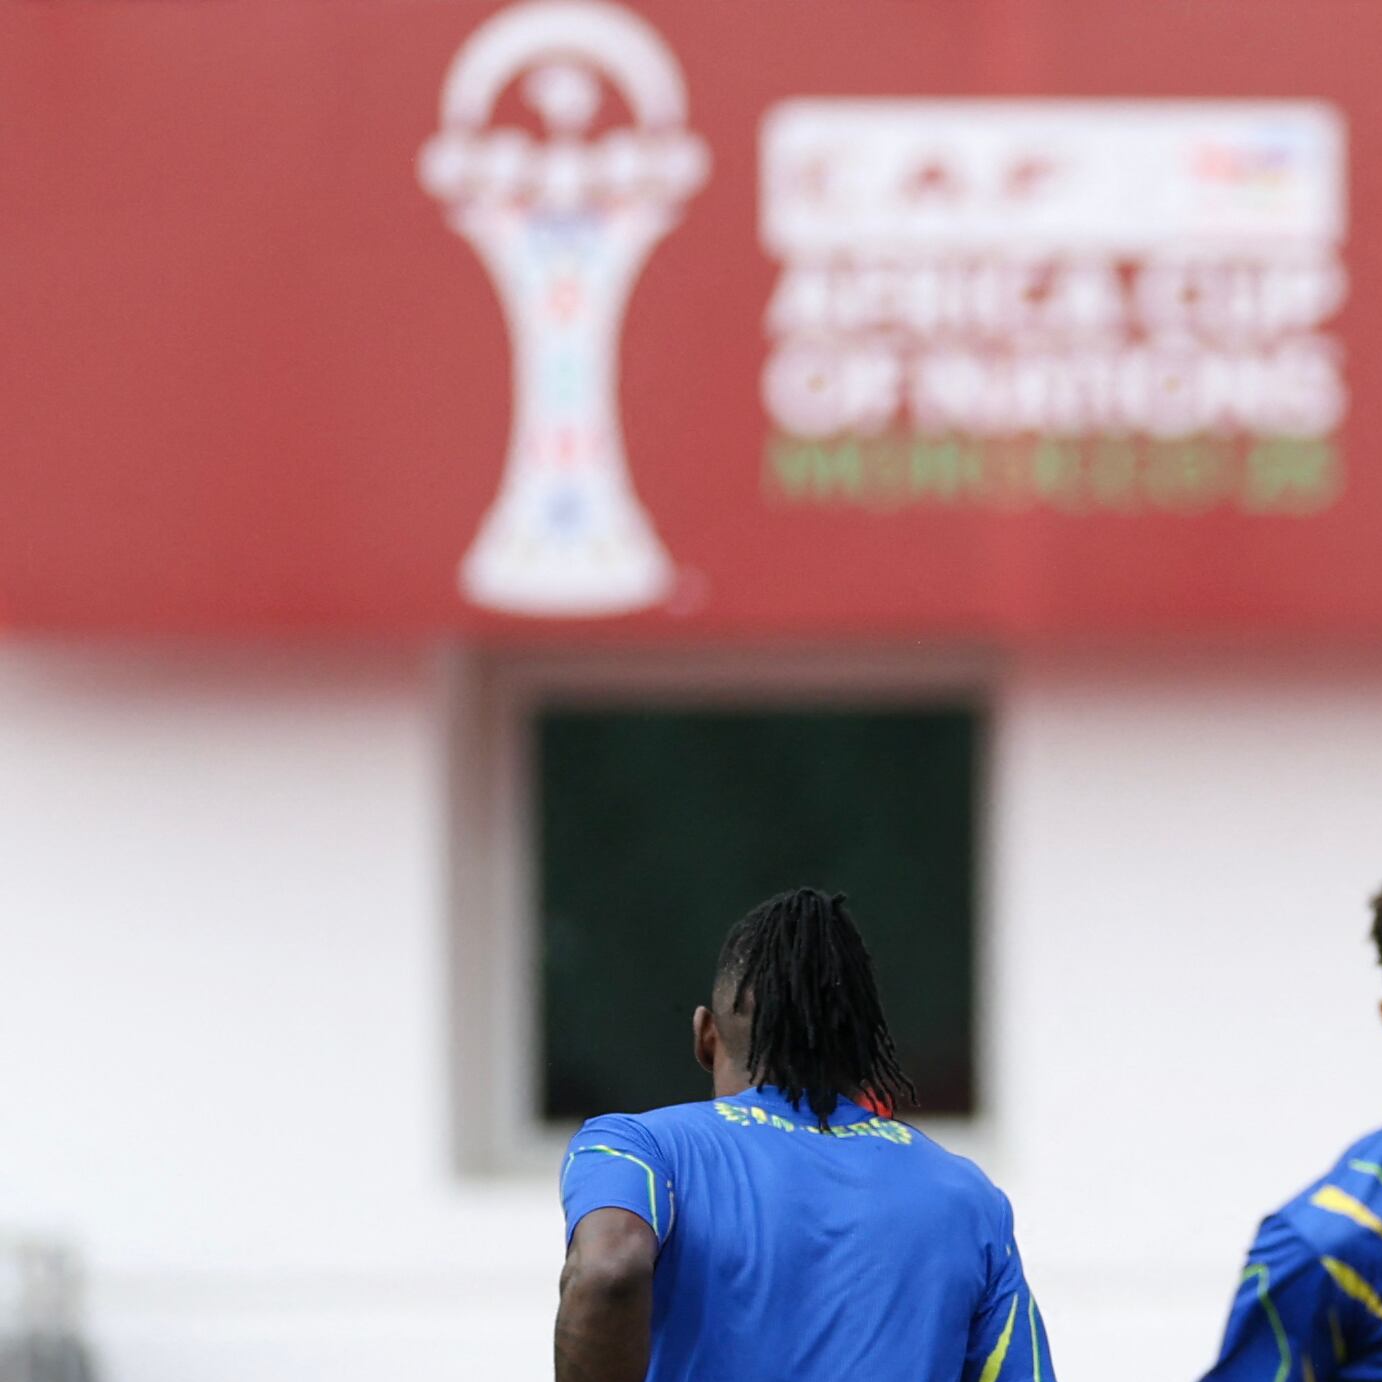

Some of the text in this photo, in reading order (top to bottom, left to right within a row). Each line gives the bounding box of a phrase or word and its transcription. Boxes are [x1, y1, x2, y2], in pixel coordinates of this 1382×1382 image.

[772, 254, 1346, 332] AFRICA CUP
[765, 340, 1346, 434] OF NATIONS
